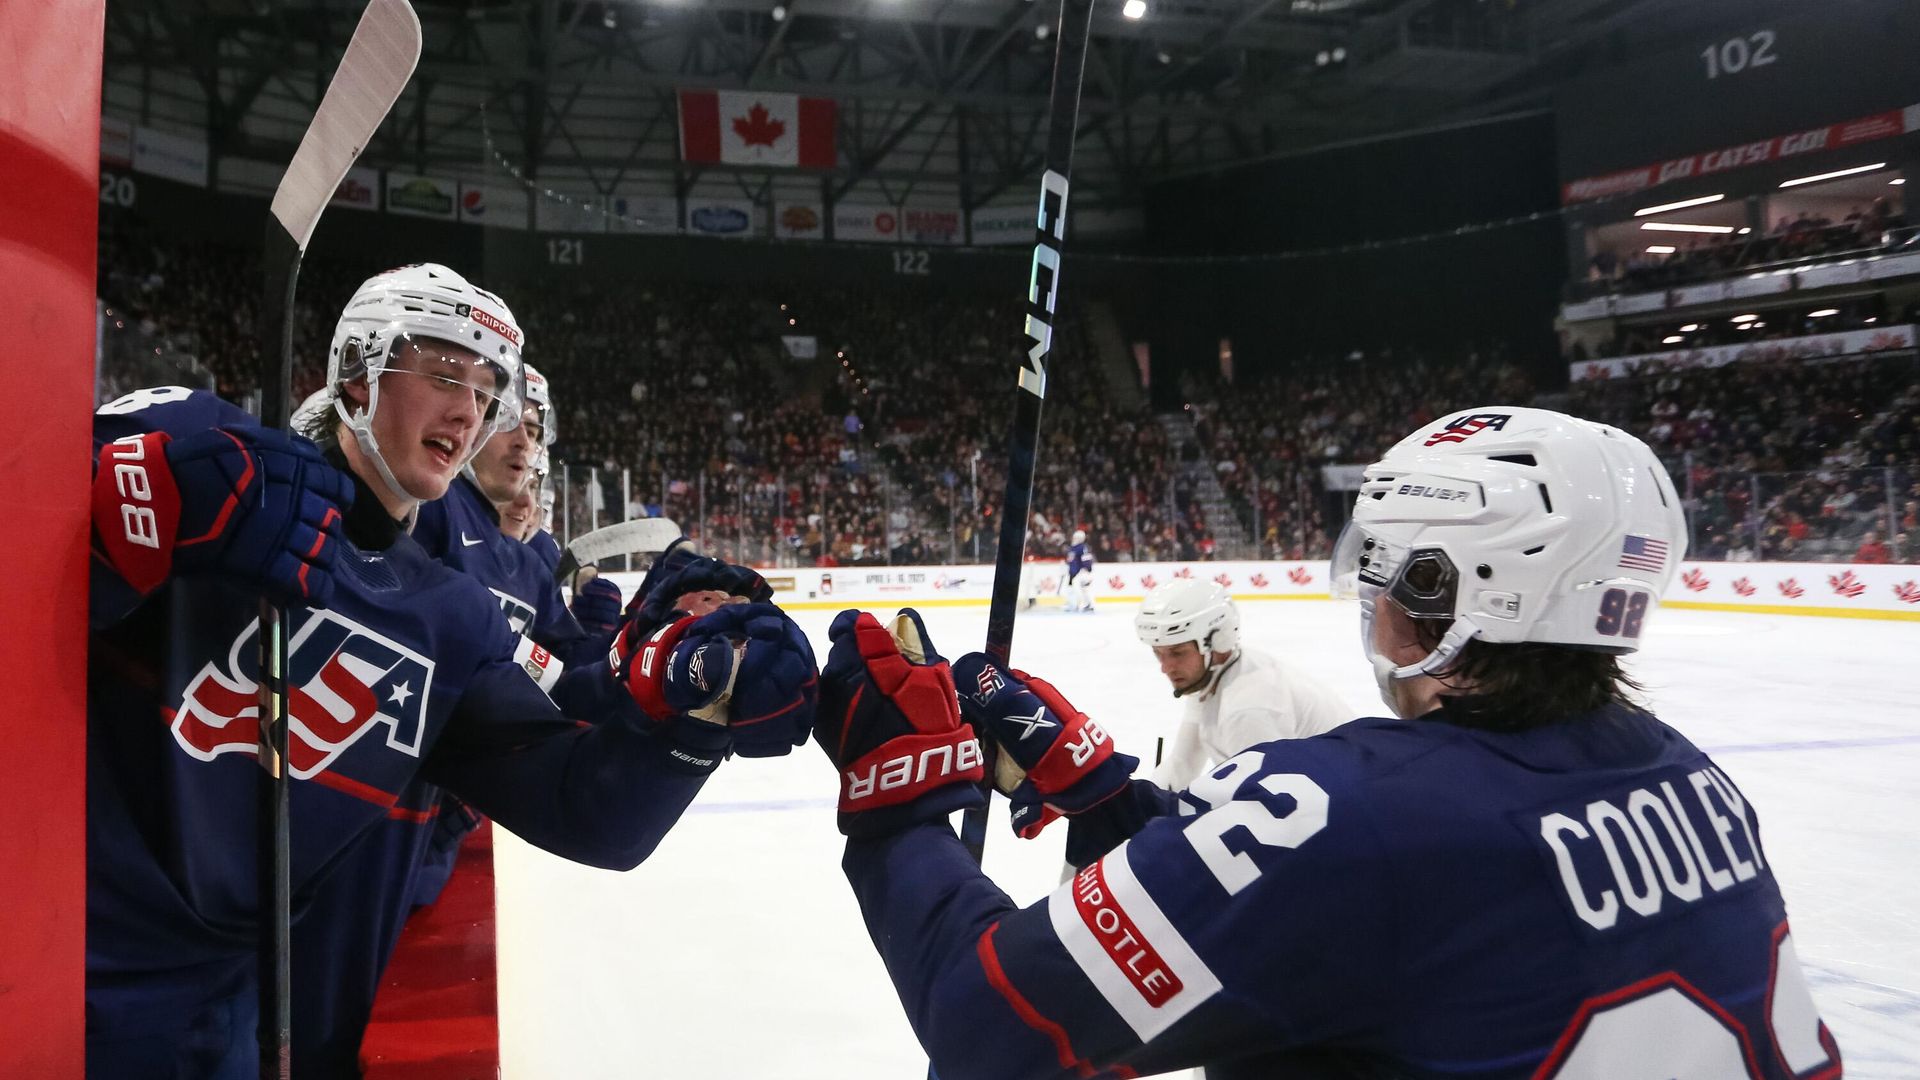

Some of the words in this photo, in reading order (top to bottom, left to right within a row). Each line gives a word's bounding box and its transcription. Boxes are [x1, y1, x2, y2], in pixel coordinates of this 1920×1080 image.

[1700, 29, 1778, 79] 102
[1657, 160, 1694, 185] GO
[1698, 140, 1773, 175] CATS!
[1778, 127, 1830, 157] GO!
[99, 172, 136, 208] 20
[547, 239, 585, 266] 121
[891, 249, 931, 277] 122
[1018, 168, 1069, 400] CCM
[473, 309, 519, 343] CHIPOTL
[1423, 413, 1513, 448] USA
[112, 433, 160, 549] BAU
[1398, 484, 1471, 504] BAUER
[1595, 588, 1649, 638] 92
[170, 607, 436, 780] USA
[670, 748, 714, 767] BAUER
[1178, 749, 1331, 898] 92
[1539, 766, 1765, 931] COOLEY
[1077, 861, 1173, 997] CHIPOTLE
